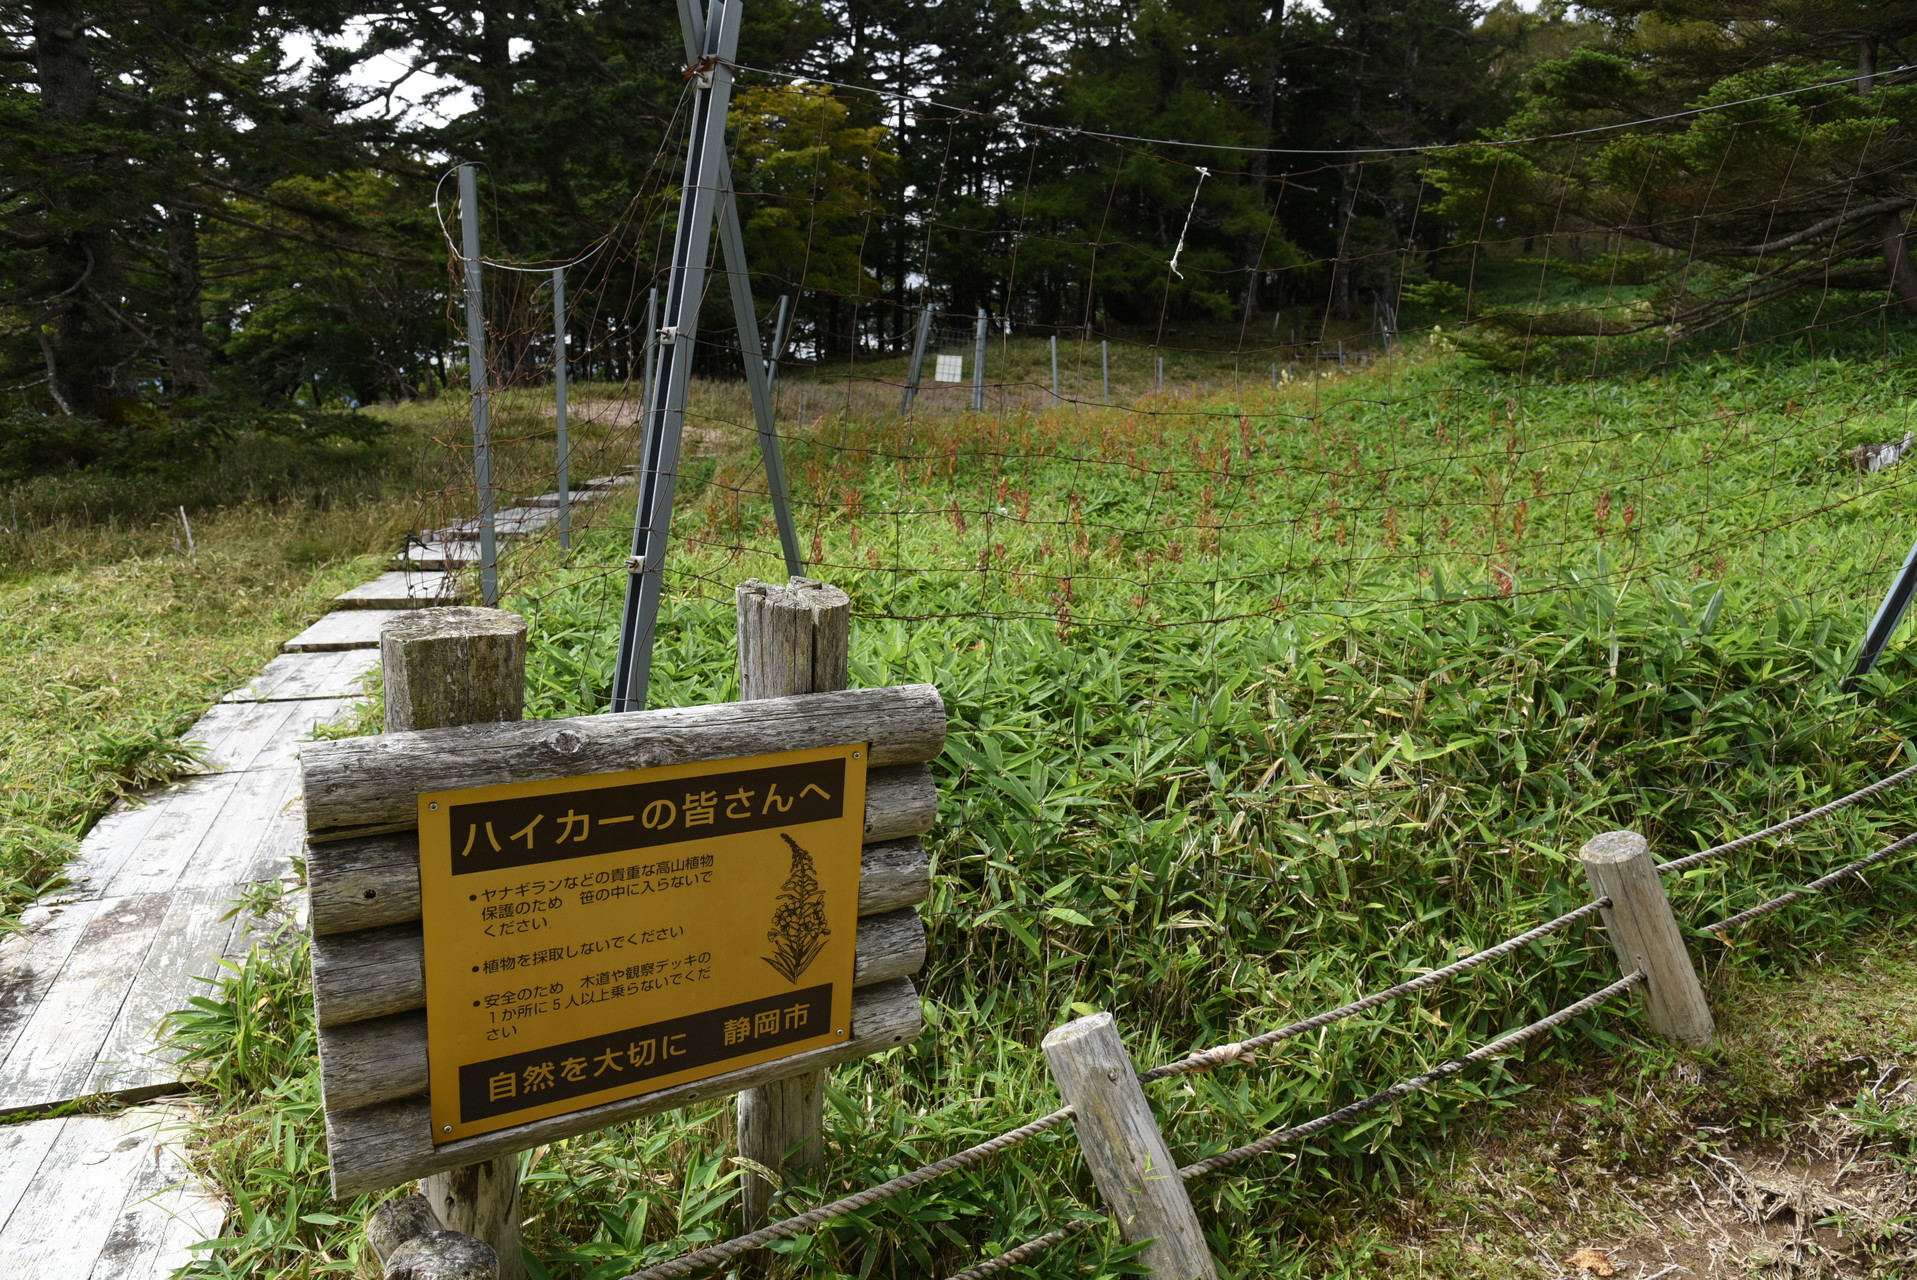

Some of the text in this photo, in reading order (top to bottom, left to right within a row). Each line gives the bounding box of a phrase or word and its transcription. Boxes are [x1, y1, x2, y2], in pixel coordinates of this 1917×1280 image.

[461, 782, 831, 857] ハイカーの皆さんへ
[481, 853, 714, 902] ヤナギランなどの貴重な高山植物
[481, 871, 713, 922] 保護のため 笹の中に入らないで
[483, 918, 548, 938] ください
[483, 925, 685, 974] 植物を採取しないでください
[484, 951, 712, 1010] 安全のため 木道や観察デッキの
[486, 1025, 518, 1042] さい
[488, 1003, 810, 1102] 自然を大切に 静岡市
